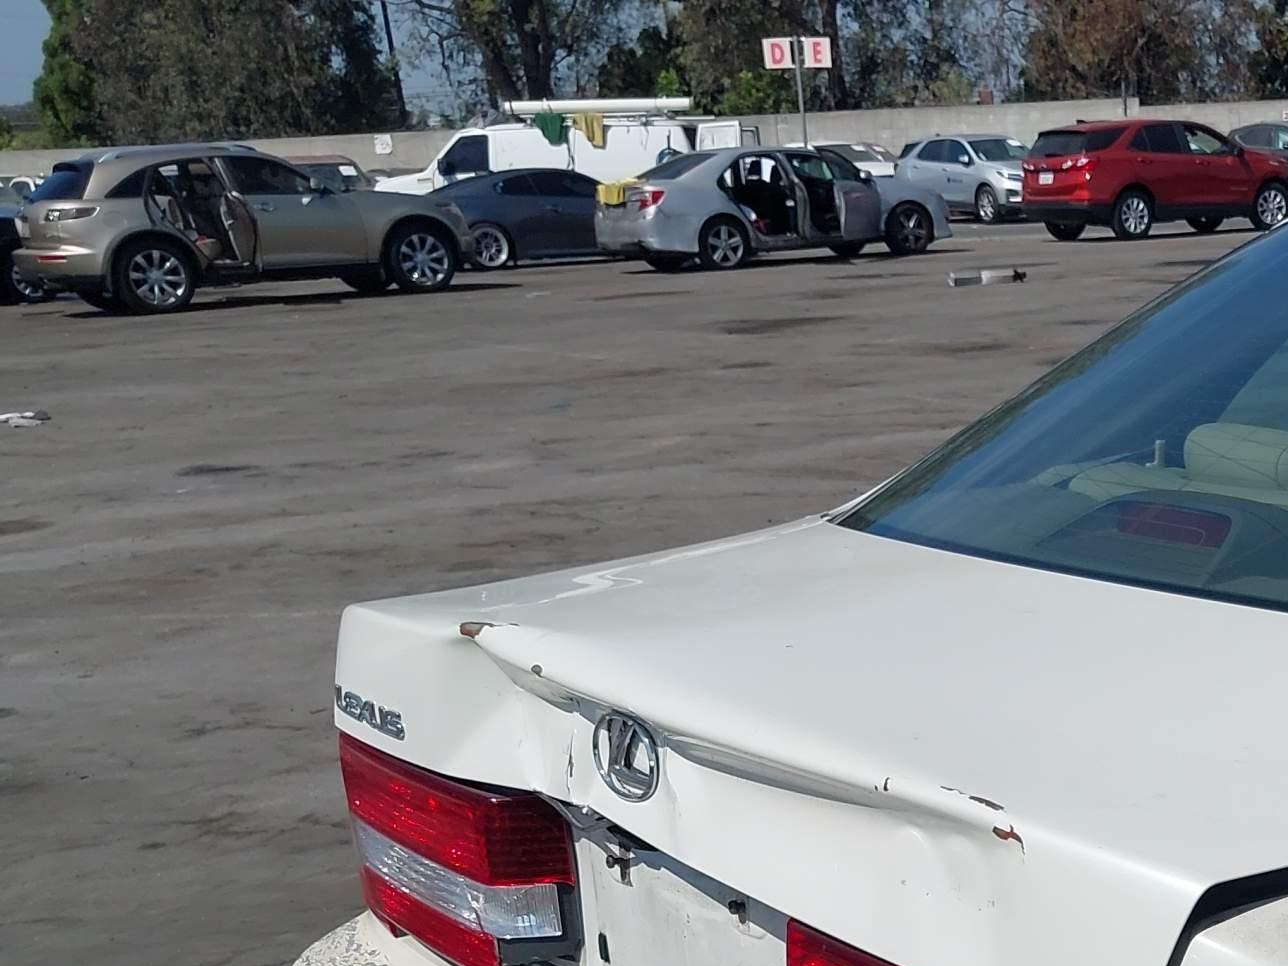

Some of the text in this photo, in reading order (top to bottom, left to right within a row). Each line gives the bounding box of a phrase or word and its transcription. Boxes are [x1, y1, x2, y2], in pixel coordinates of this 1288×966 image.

[770, 42, 785, 65] D
[812, 41, 822, 64] E
[335, 684, 406, 742] LEXUS
